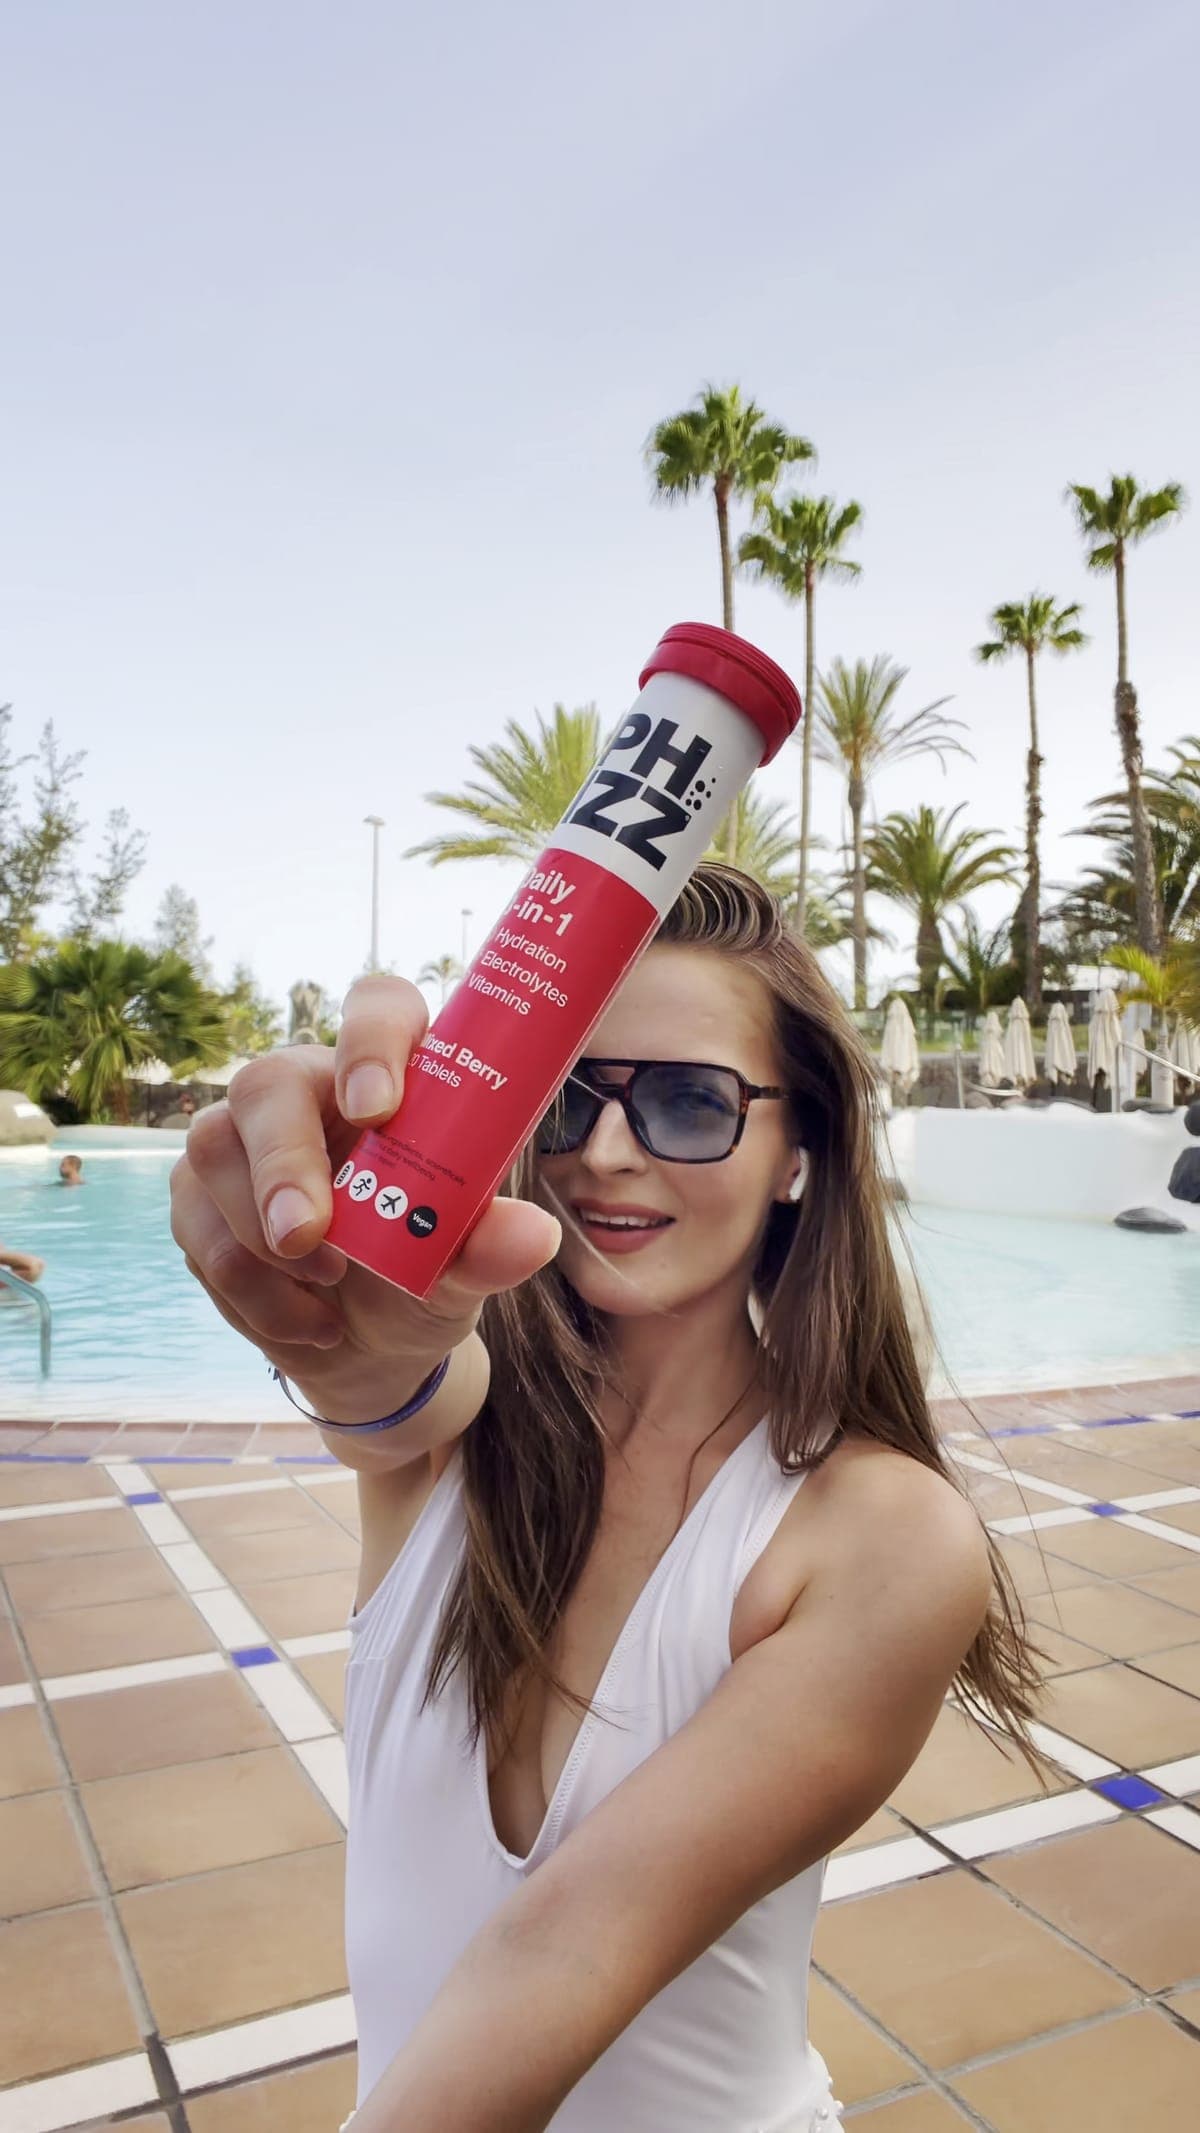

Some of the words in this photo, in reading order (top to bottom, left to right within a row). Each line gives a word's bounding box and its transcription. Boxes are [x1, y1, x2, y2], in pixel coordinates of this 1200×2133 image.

[598, 713, 712, 800] PH
[496, 926, 568, 974] Hydration
[468, 973, 531, 1015] Vitamins
[481, 950, 568, 1007] Electrolytes
[418, 1055, 462, 1088] Tablets
[455, 1047, 508, 1091] Berry
[412, 1212, 434, 1231] Vegan
